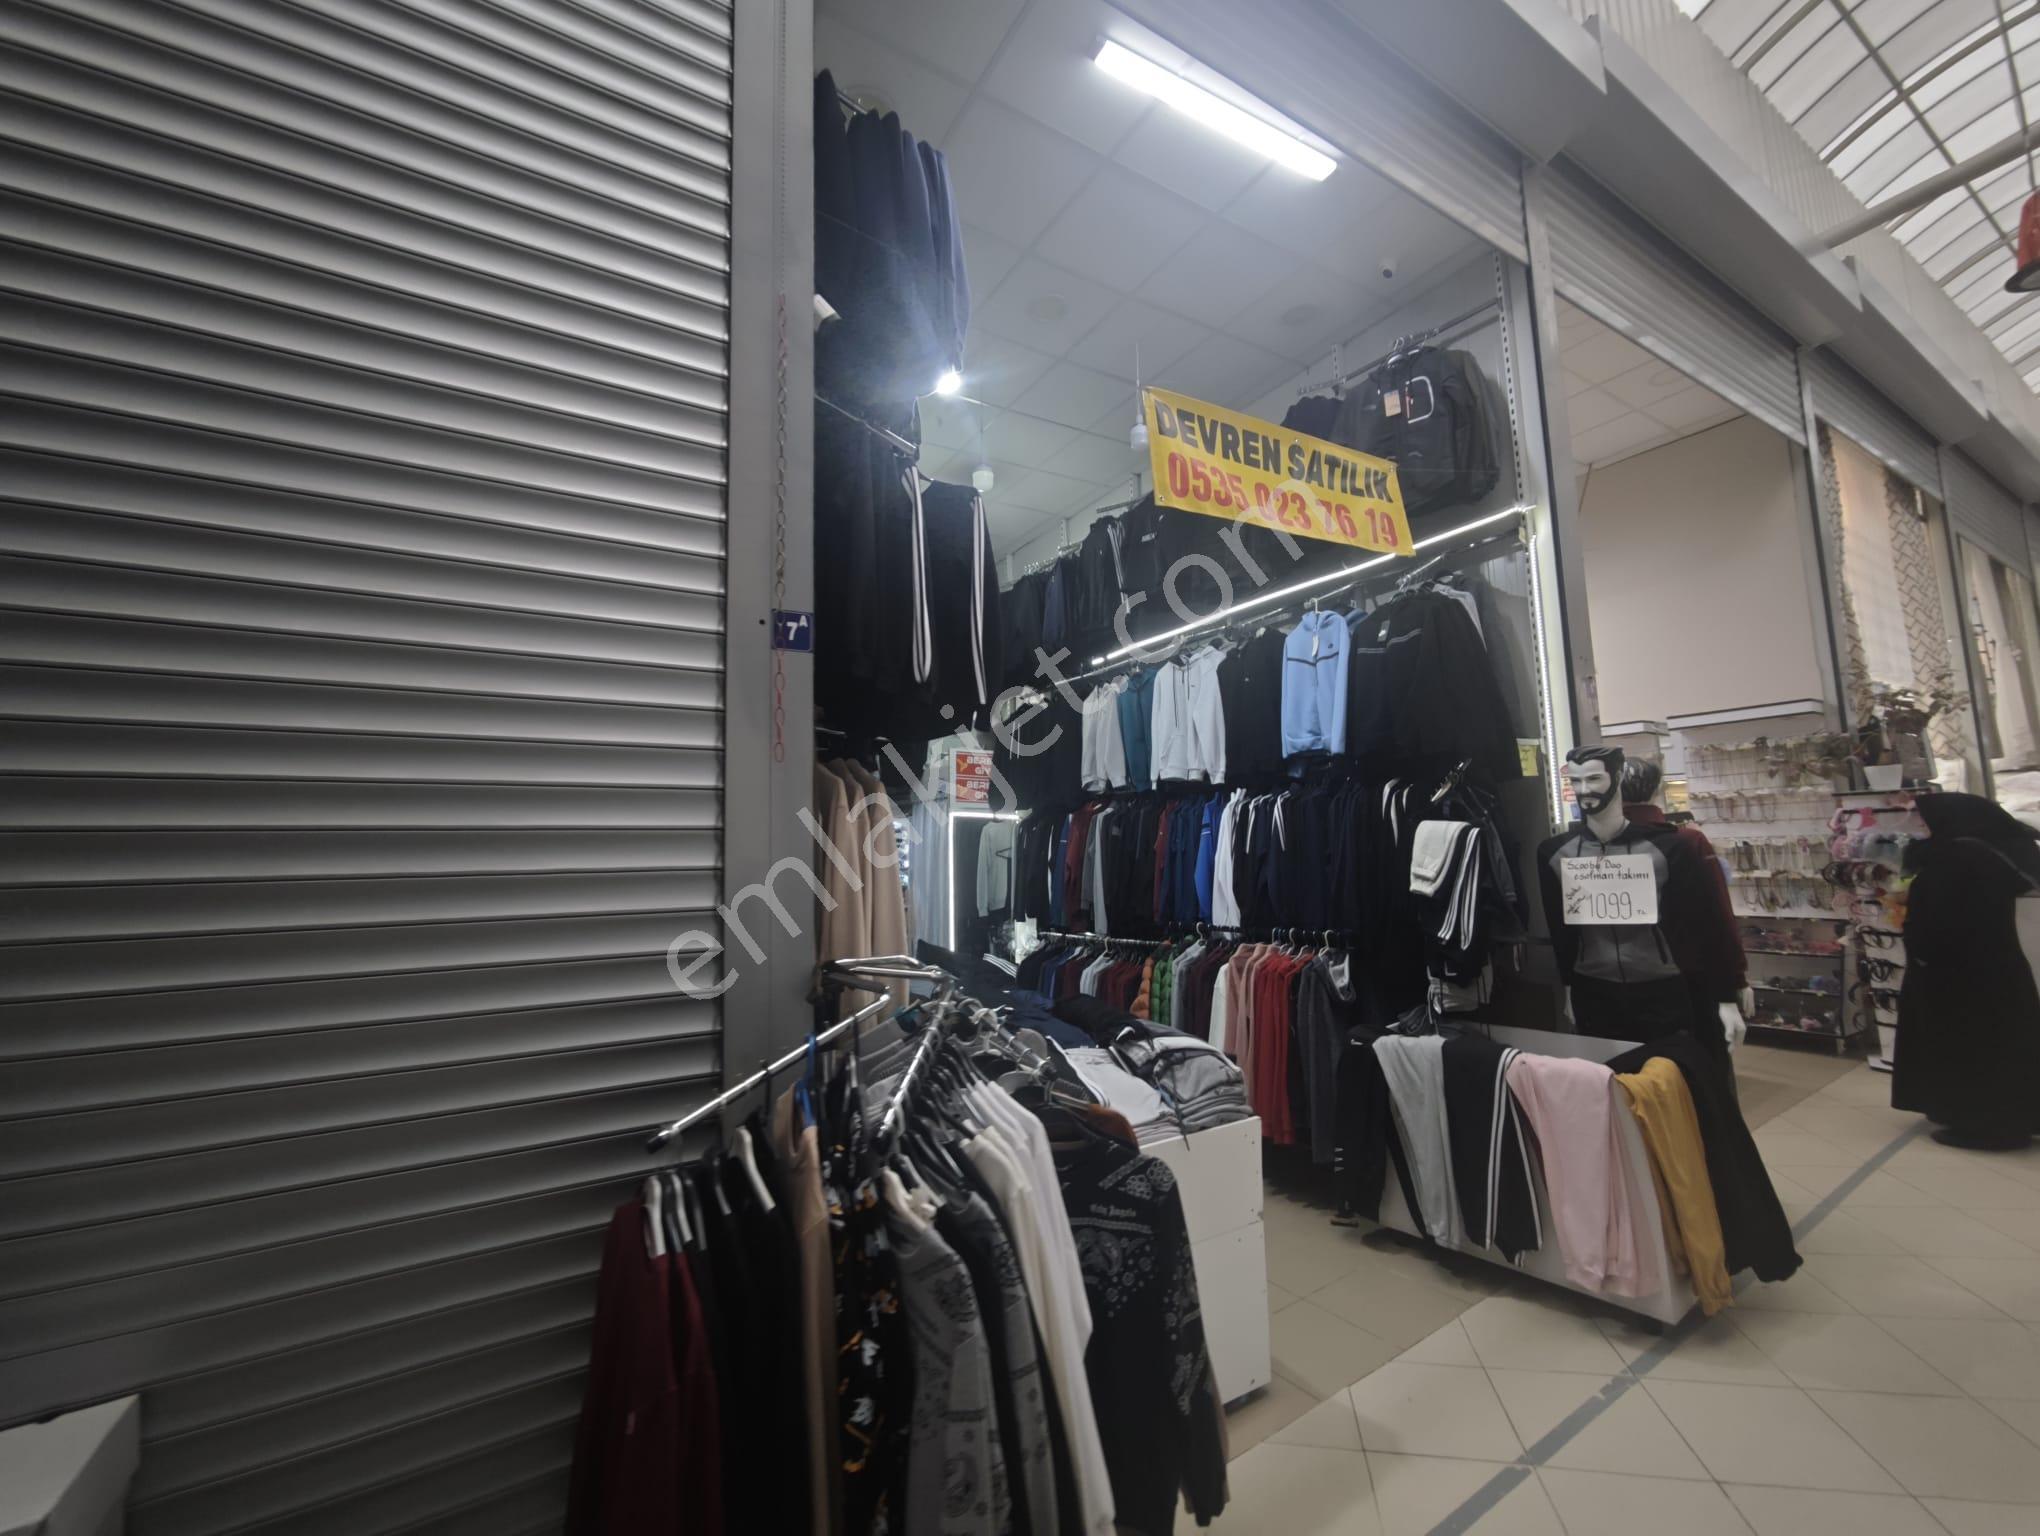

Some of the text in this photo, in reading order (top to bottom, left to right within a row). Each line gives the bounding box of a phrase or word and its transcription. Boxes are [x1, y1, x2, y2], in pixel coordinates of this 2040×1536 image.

[1154, 399, 1394, 503] DEVREN SATILIK
[1168, 452, 1398, 547] 0535 023 76 19
[1590, 892, 1632, 919] 1099
